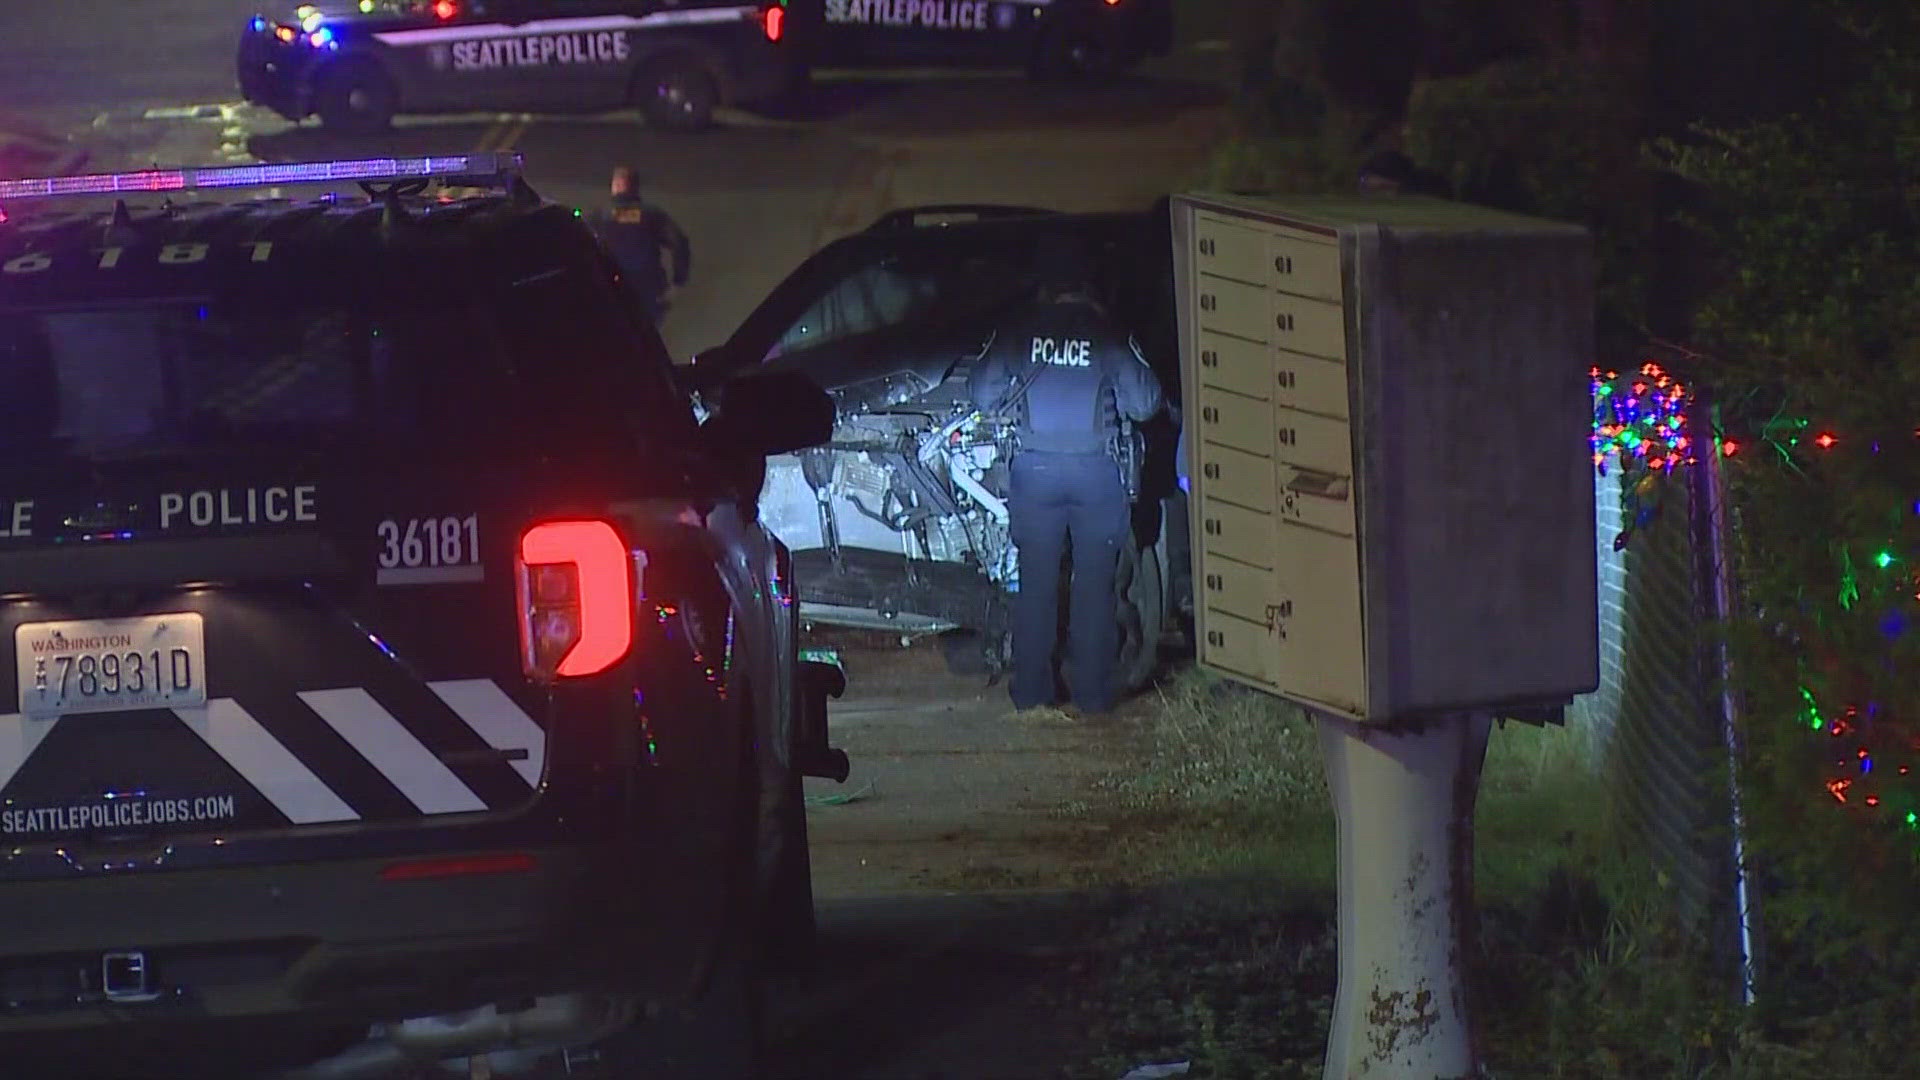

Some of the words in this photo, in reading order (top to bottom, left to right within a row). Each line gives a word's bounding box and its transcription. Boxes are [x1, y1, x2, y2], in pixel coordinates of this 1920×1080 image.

[1031, 336, 1091, 367] POLICE
[160, 485, 317, 528] POLICE
[377, 512, 479, 568] 36181
[32, 634, 131, 652] WASHINGTON
[55, 648, 191, 699] 78931D
[2, 796, 234, 833] SEATTLEPOLICEJOBS.COM
